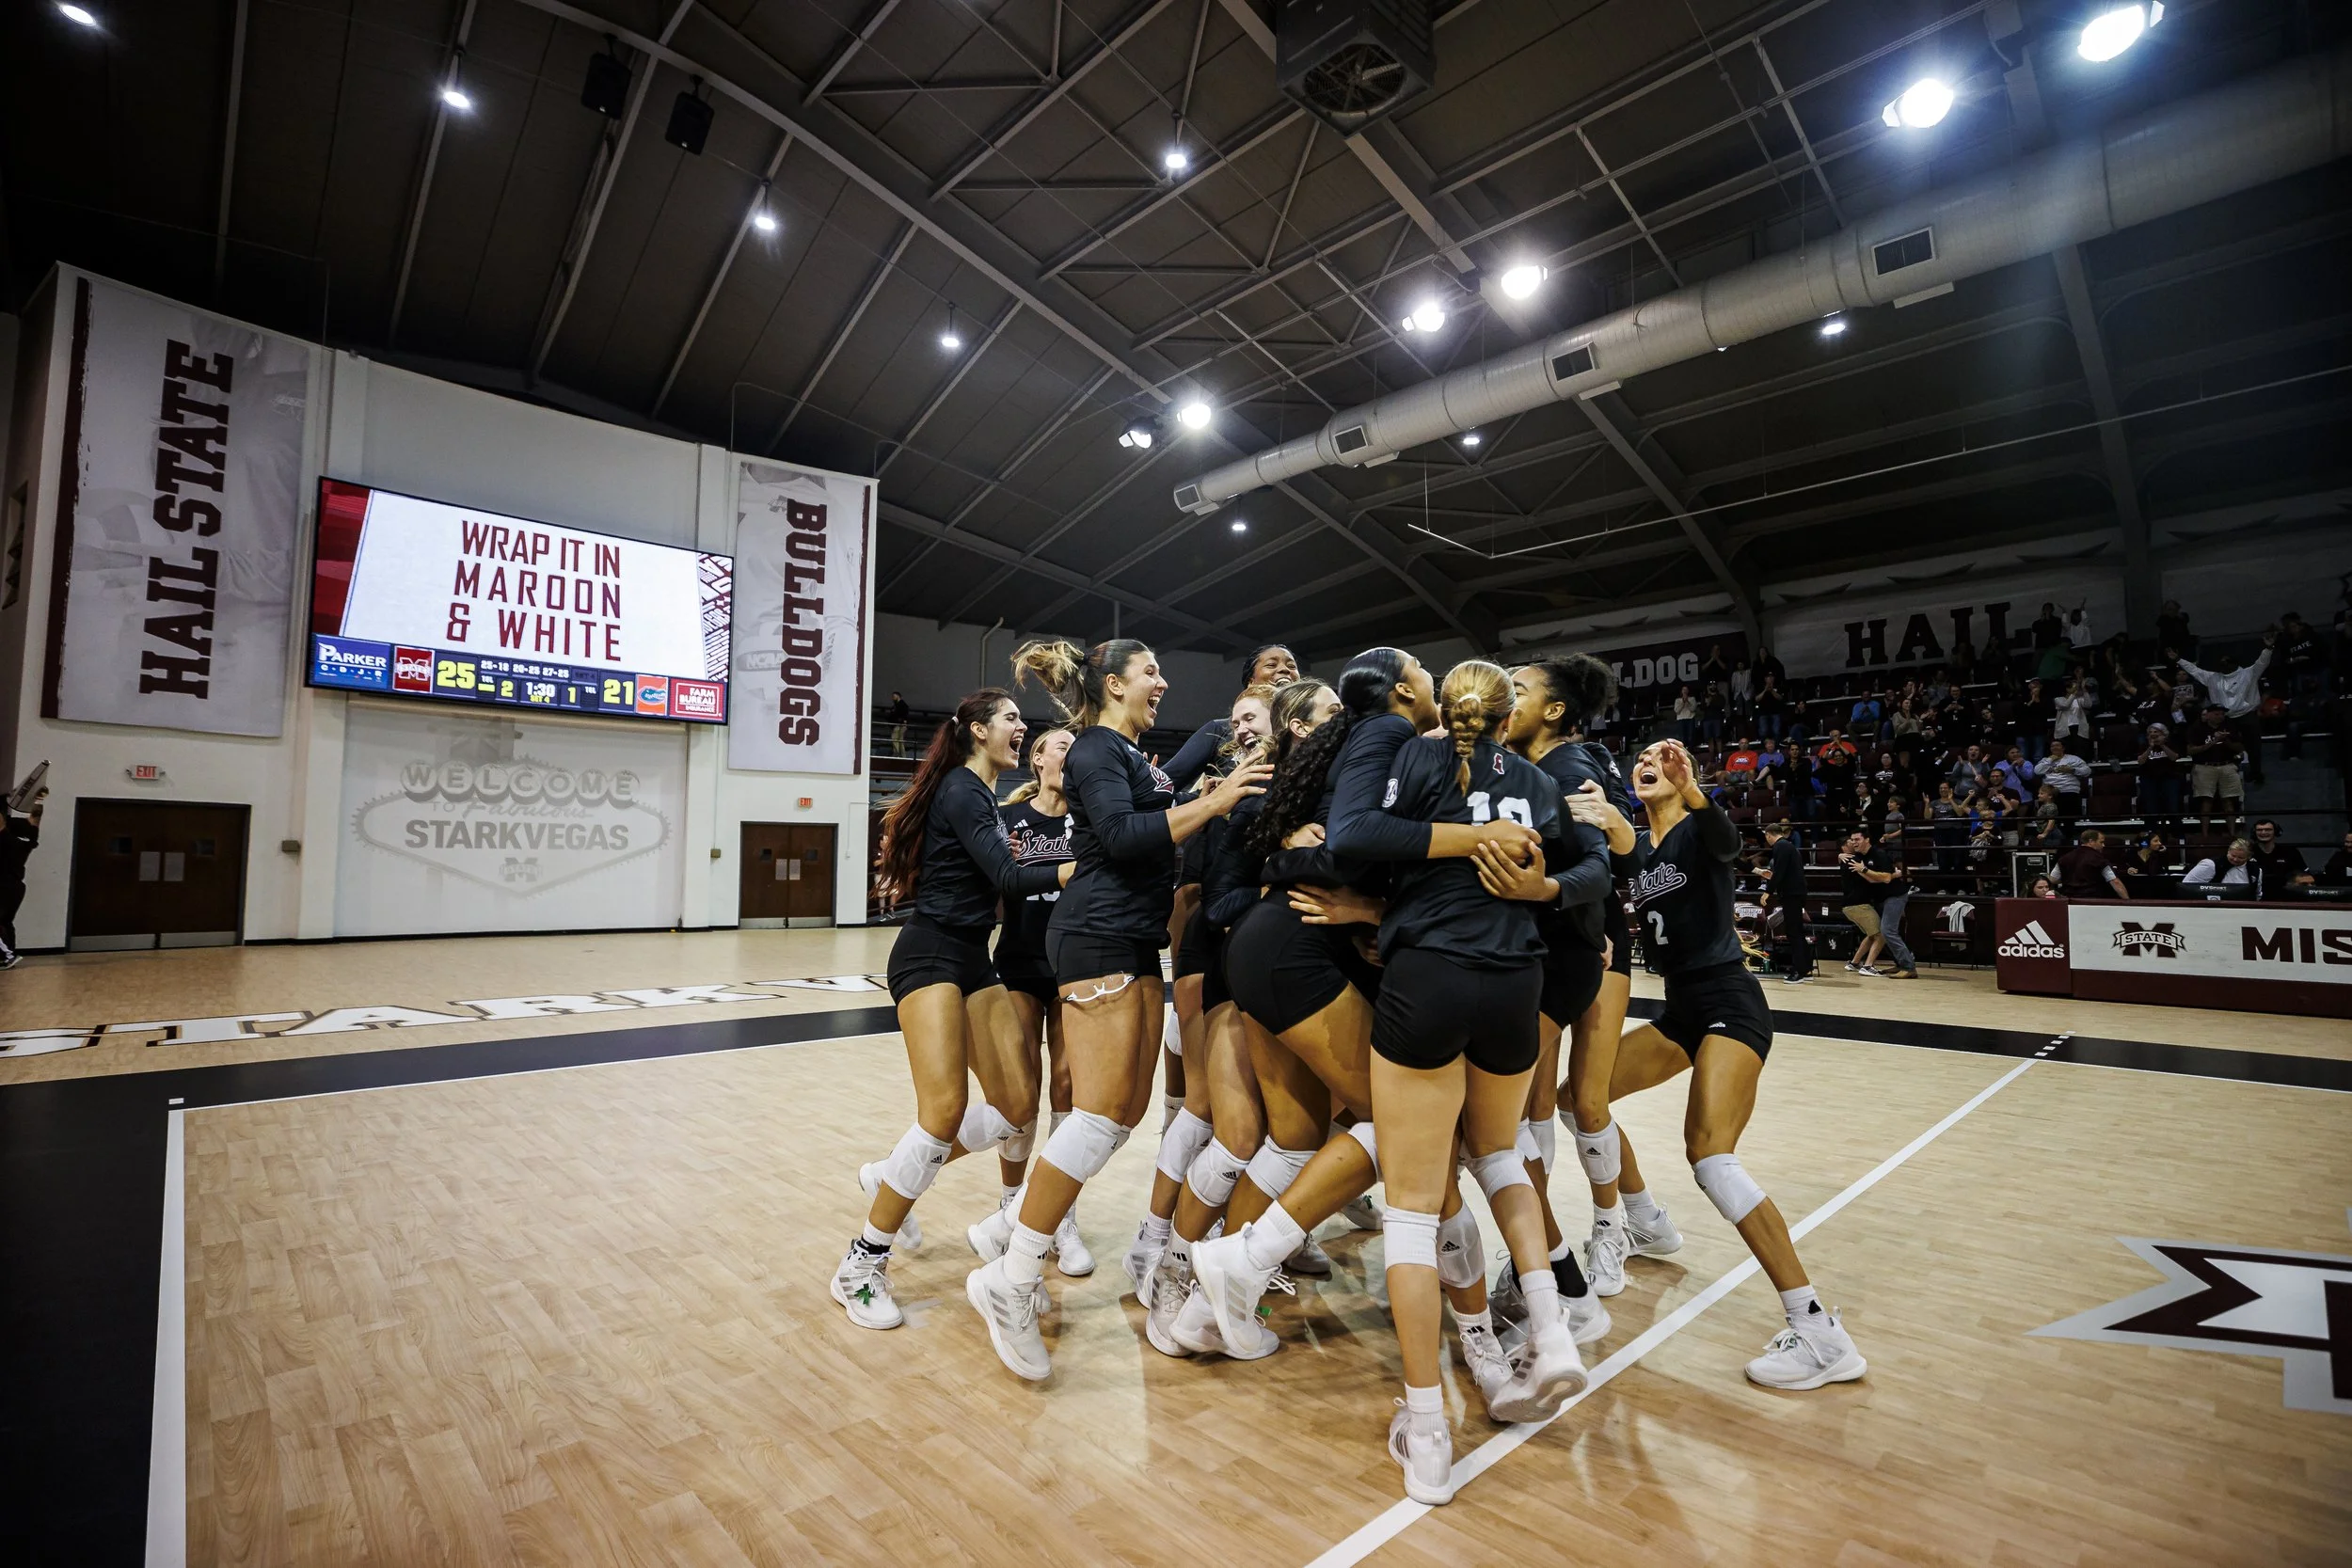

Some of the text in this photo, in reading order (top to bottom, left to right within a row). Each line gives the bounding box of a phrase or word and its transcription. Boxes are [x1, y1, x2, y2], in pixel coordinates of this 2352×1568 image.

[138, 339, 233, 700] HAIL STATE
[462, 520, 620, 578] WRAP IT IN
[454, 561, 621, 619] MAROON
[447, 603, 621, 662] & WHITE
[778, 498, 827, 746] BULLDOGS
[1844, 602, 2033, 667] HAIL
[318, 642, 387, 668] PARKER
[437, 660, 476, 689] 25
[1612, 652, 1699, 689] LDOG
[501, 680, 514, 698] 2
[526, 682, 556, 698] 1:30
[567, 687, 577, 704] 1
[603, 679, 634, 705] 21
[679, 694, 715, 705] BUREAU
[690, 688, 715, 697] FARM
[136, 766, 157, 777] EXIT
[405, 765, 631, 796] WELCOME
[405, 818, 629, 850] STARKVEGAS
[1647, 911, 1669, 945] 2
[2125, 933, 2172, 945] STATE
[1998, 943, 2065, 958] adidas
[2241, 927, 2352, 965] MIS
